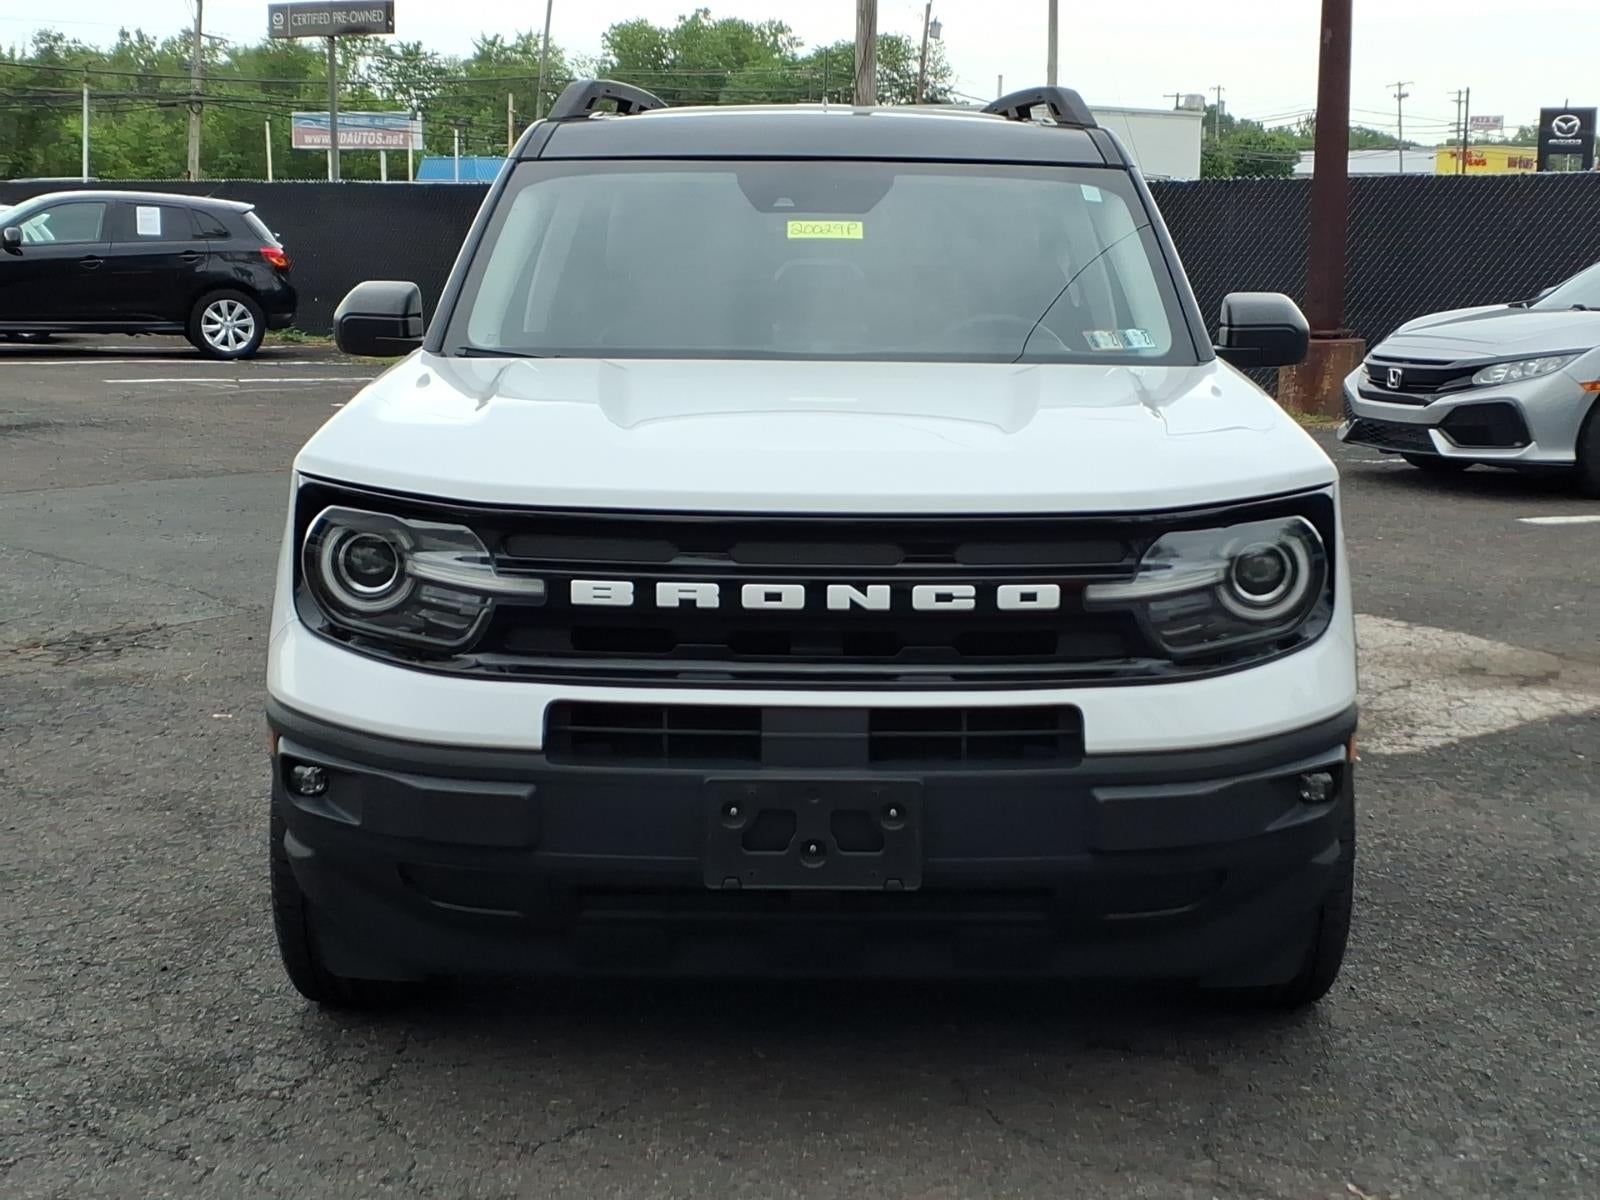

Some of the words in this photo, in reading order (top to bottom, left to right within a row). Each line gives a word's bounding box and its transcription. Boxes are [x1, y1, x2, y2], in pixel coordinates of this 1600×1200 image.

[291, 12, 330, 26] CERTIFIED
[332, 9, 384, 24] PRE-OWNED
[570, 579, 1061, 611] BRONCO
